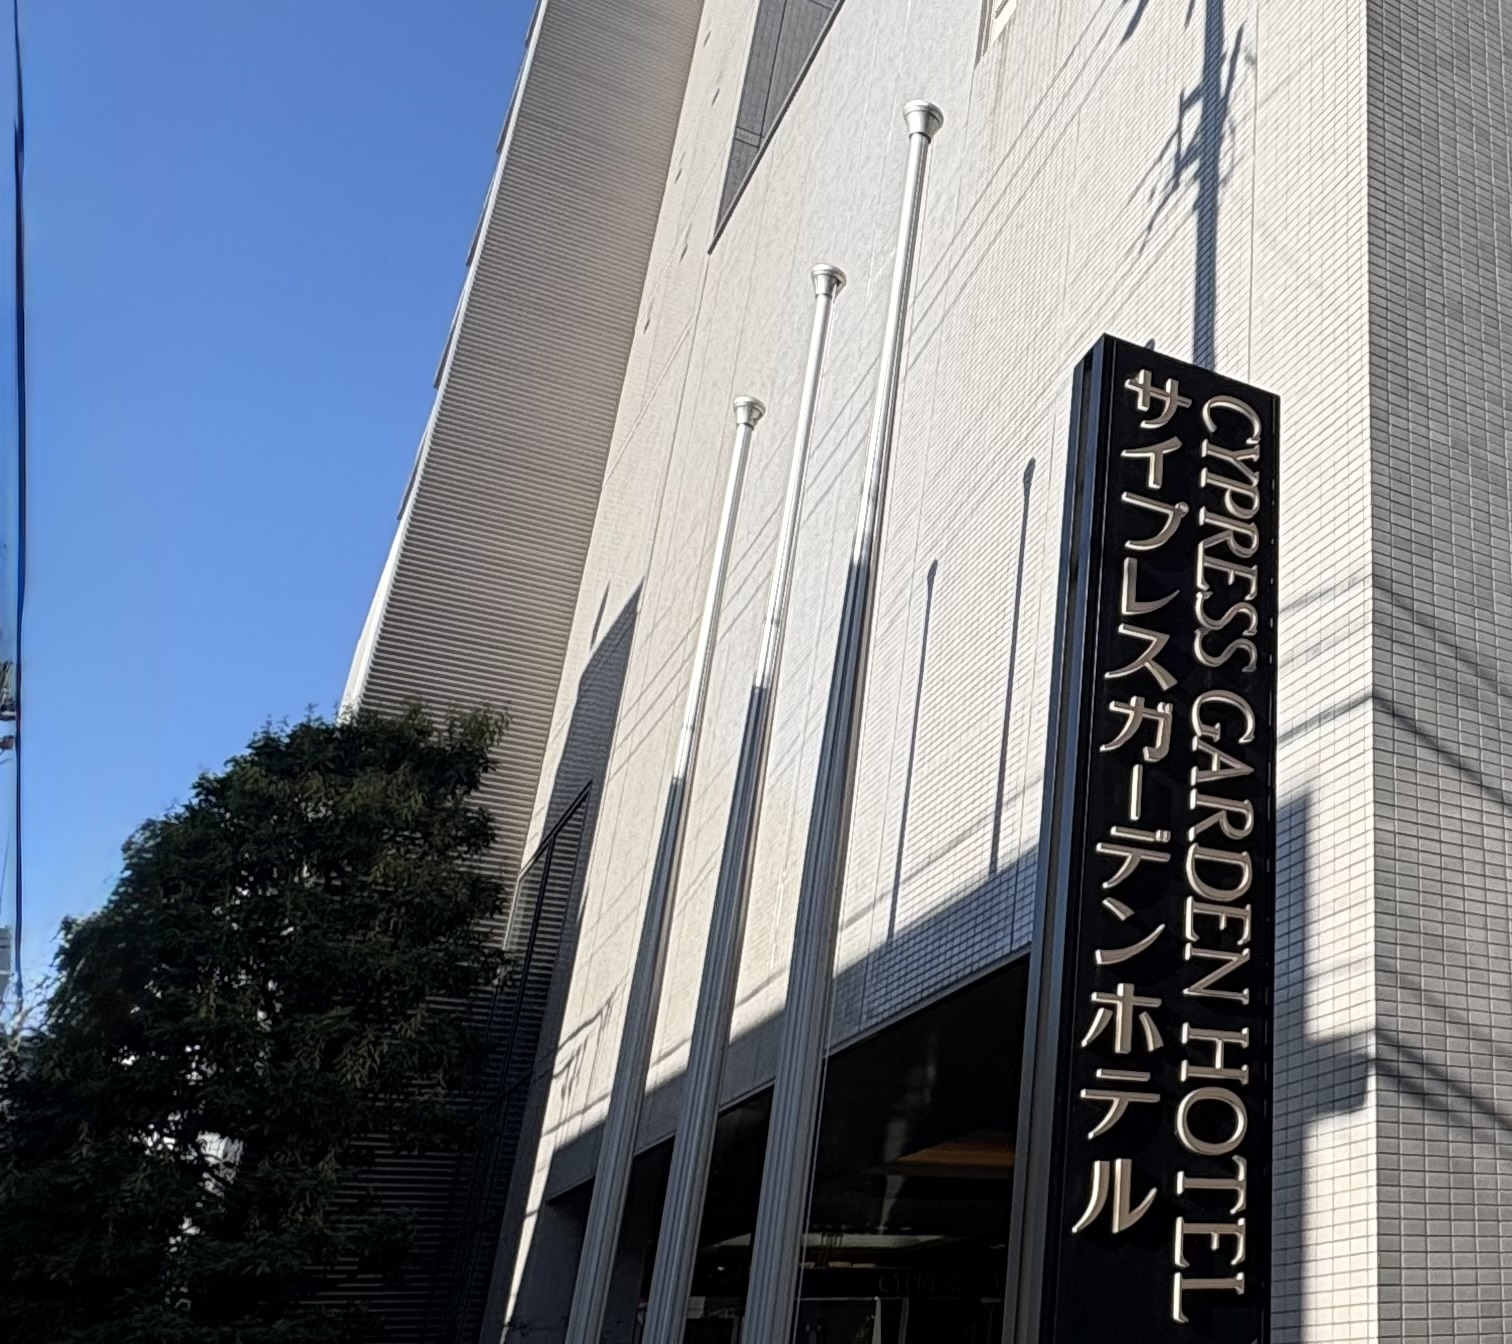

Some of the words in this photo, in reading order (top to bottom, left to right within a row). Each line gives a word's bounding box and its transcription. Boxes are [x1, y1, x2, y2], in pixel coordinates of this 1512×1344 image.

[1193, 395, 1262, 673] CYPRESS
[1072, 369, 1192, 1233] サイプレスガーデンホテル
[1182, 689, 1256, 1006] GARDEN
[1171, 1022, 1250, 1324] HOTEL
